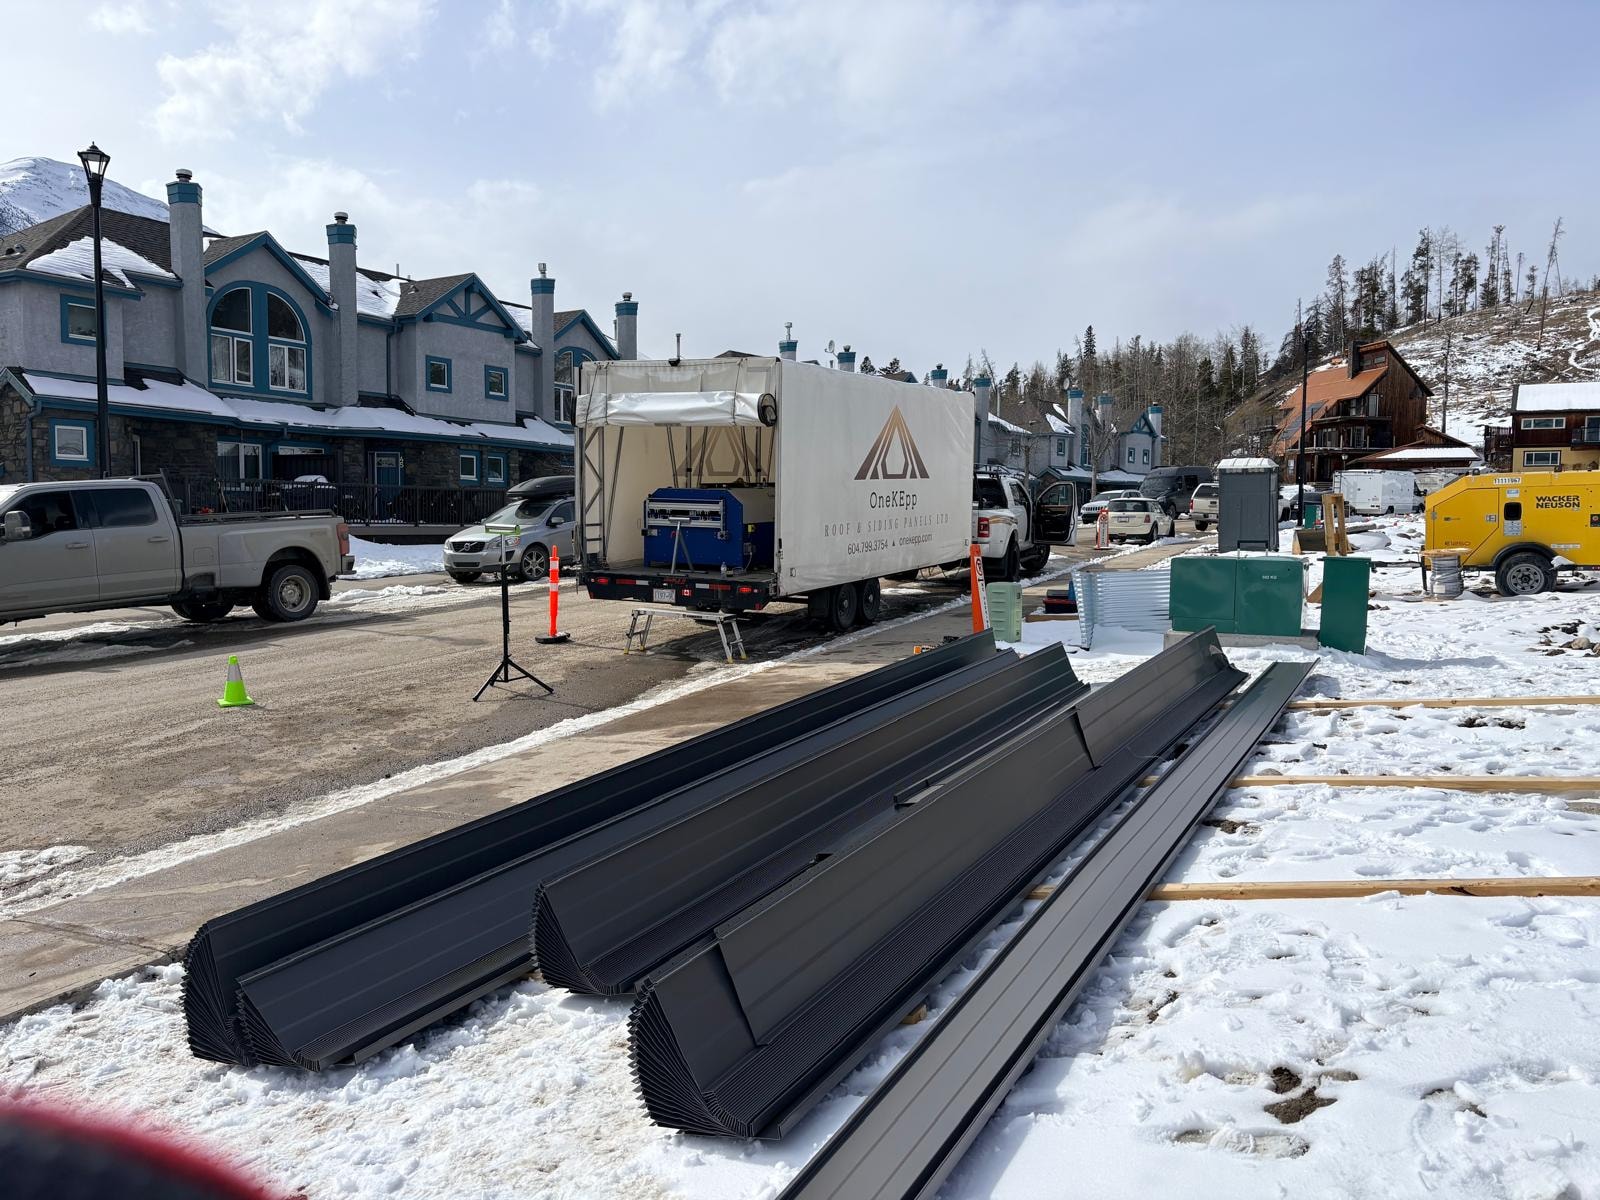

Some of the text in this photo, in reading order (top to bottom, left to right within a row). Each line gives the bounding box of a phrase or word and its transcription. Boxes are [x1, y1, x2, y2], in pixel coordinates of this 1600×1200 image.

[869, 491, 917, 510] OneKEpp
[824, 513, 949, 537] ROOF & SIDING PANELS LTD
[847, 533, 933, 555] 604.799.3754 onekepp.com
